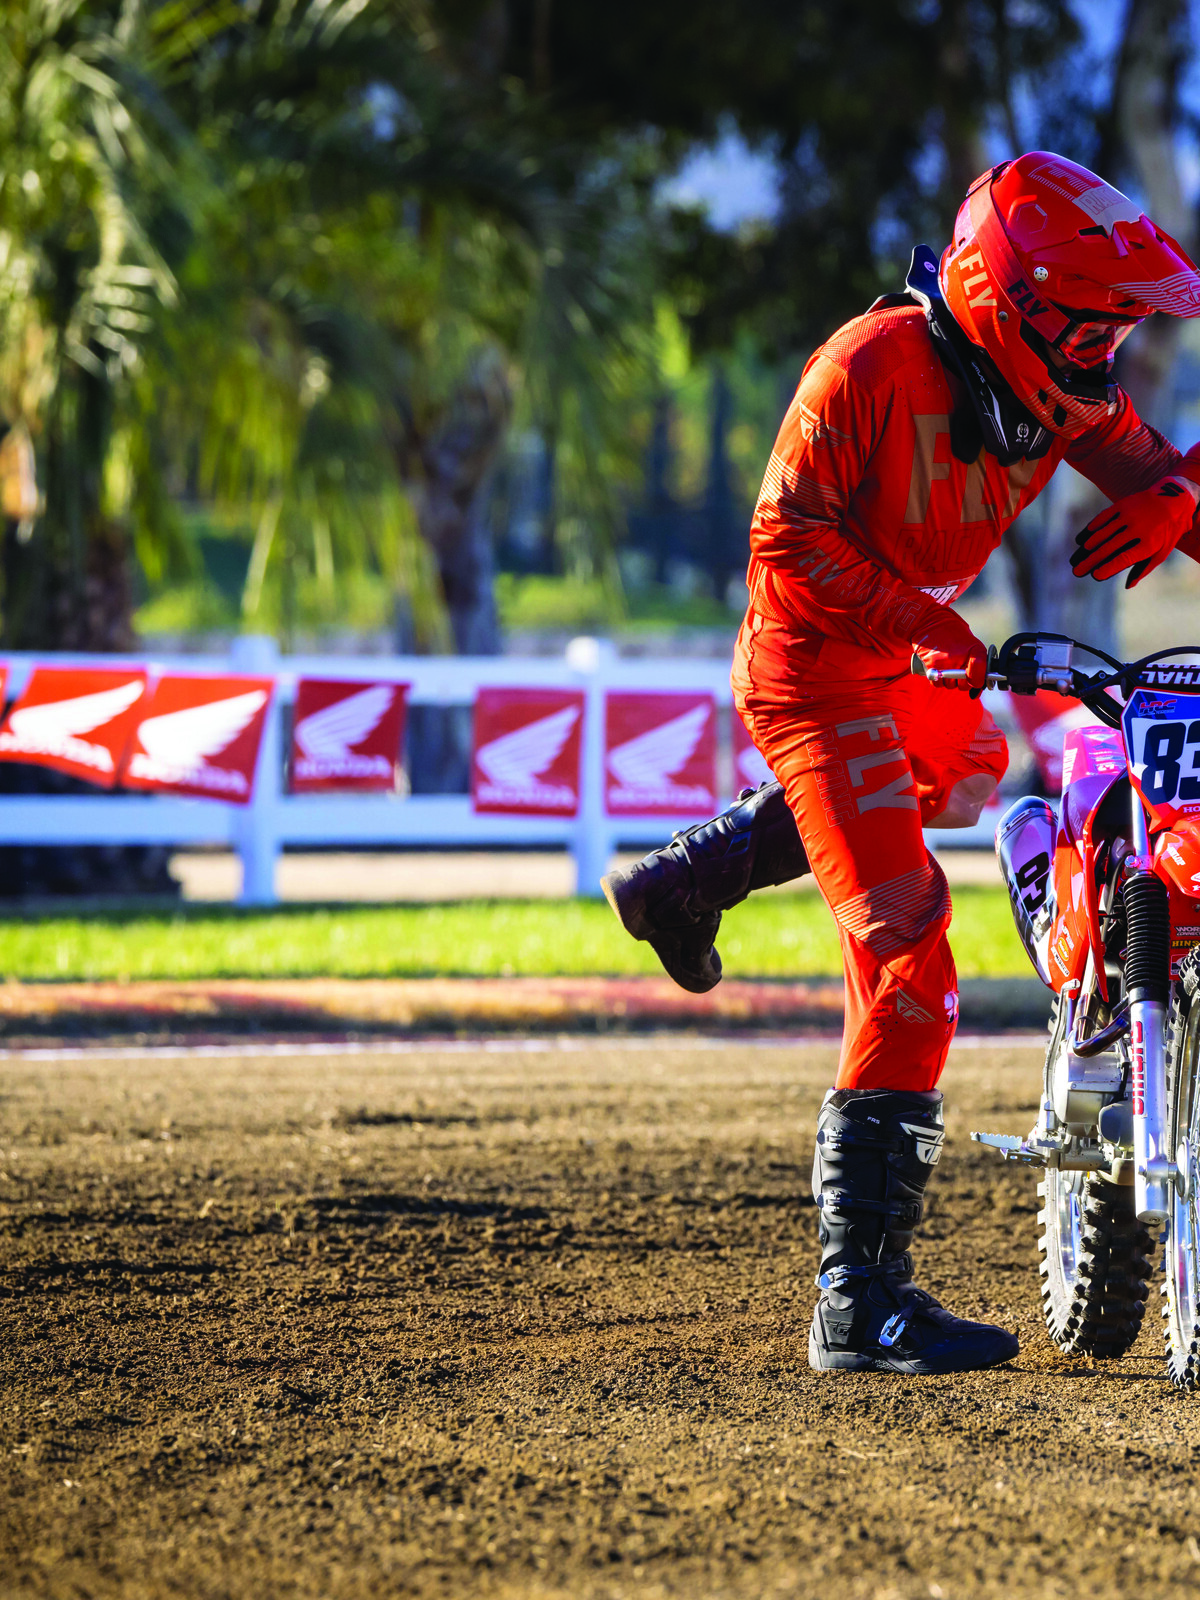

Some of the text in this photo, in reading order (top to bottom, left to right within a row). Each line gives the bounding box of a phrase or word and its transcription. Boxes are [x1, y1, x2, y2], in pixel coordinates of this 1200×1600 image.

[959, 250, 998, 310] FLY
[1007, 278, 1050, 319] FLY
[902, 414, 1041, 524] FLY
[798, 546, 845, 587] FLY
[892, 525, 1001, 575] RACI
[803, 726, 856, 828] RACING
[835, 712, 919, 815] FLY
